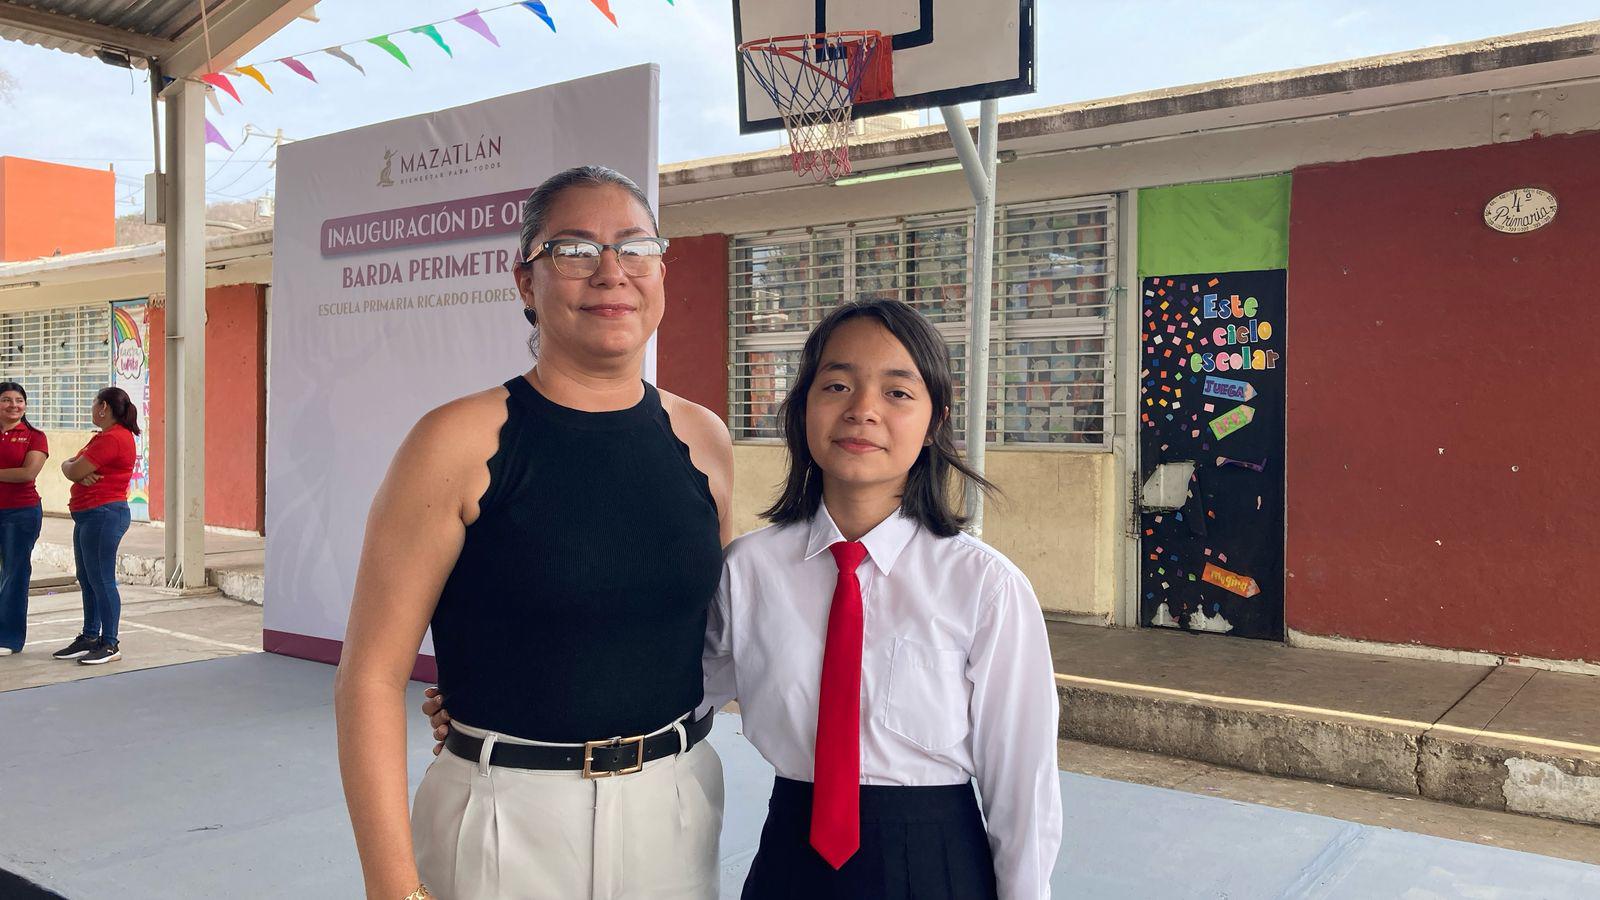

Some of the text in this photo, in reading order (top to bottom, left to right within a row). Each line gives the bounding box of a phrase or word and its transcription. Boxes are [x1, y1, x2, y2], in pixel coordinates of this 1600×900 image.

[401, 134, 502, 174] MAZATLÁN
[449, 168, 469, 177] PARA
[474, 162, 501, 174] TODOS
[328, 205, 466, 249] INAUGURACIÓN
[471, 204, 496, 230] DE
[1493, 206, 1550, 227] Primaria
[342, 261, 403, 289] BARDA
[318, 287, 517, 317] ESCUELA PRIMARIA RICARDO FLORES
[1203, 294, 1259, 319] Este
[1212, 319, 1272, 347] ciclo
[1190, 346, 1280, 373] escolar
[1204, 379, 1245, 399] JUEGA
